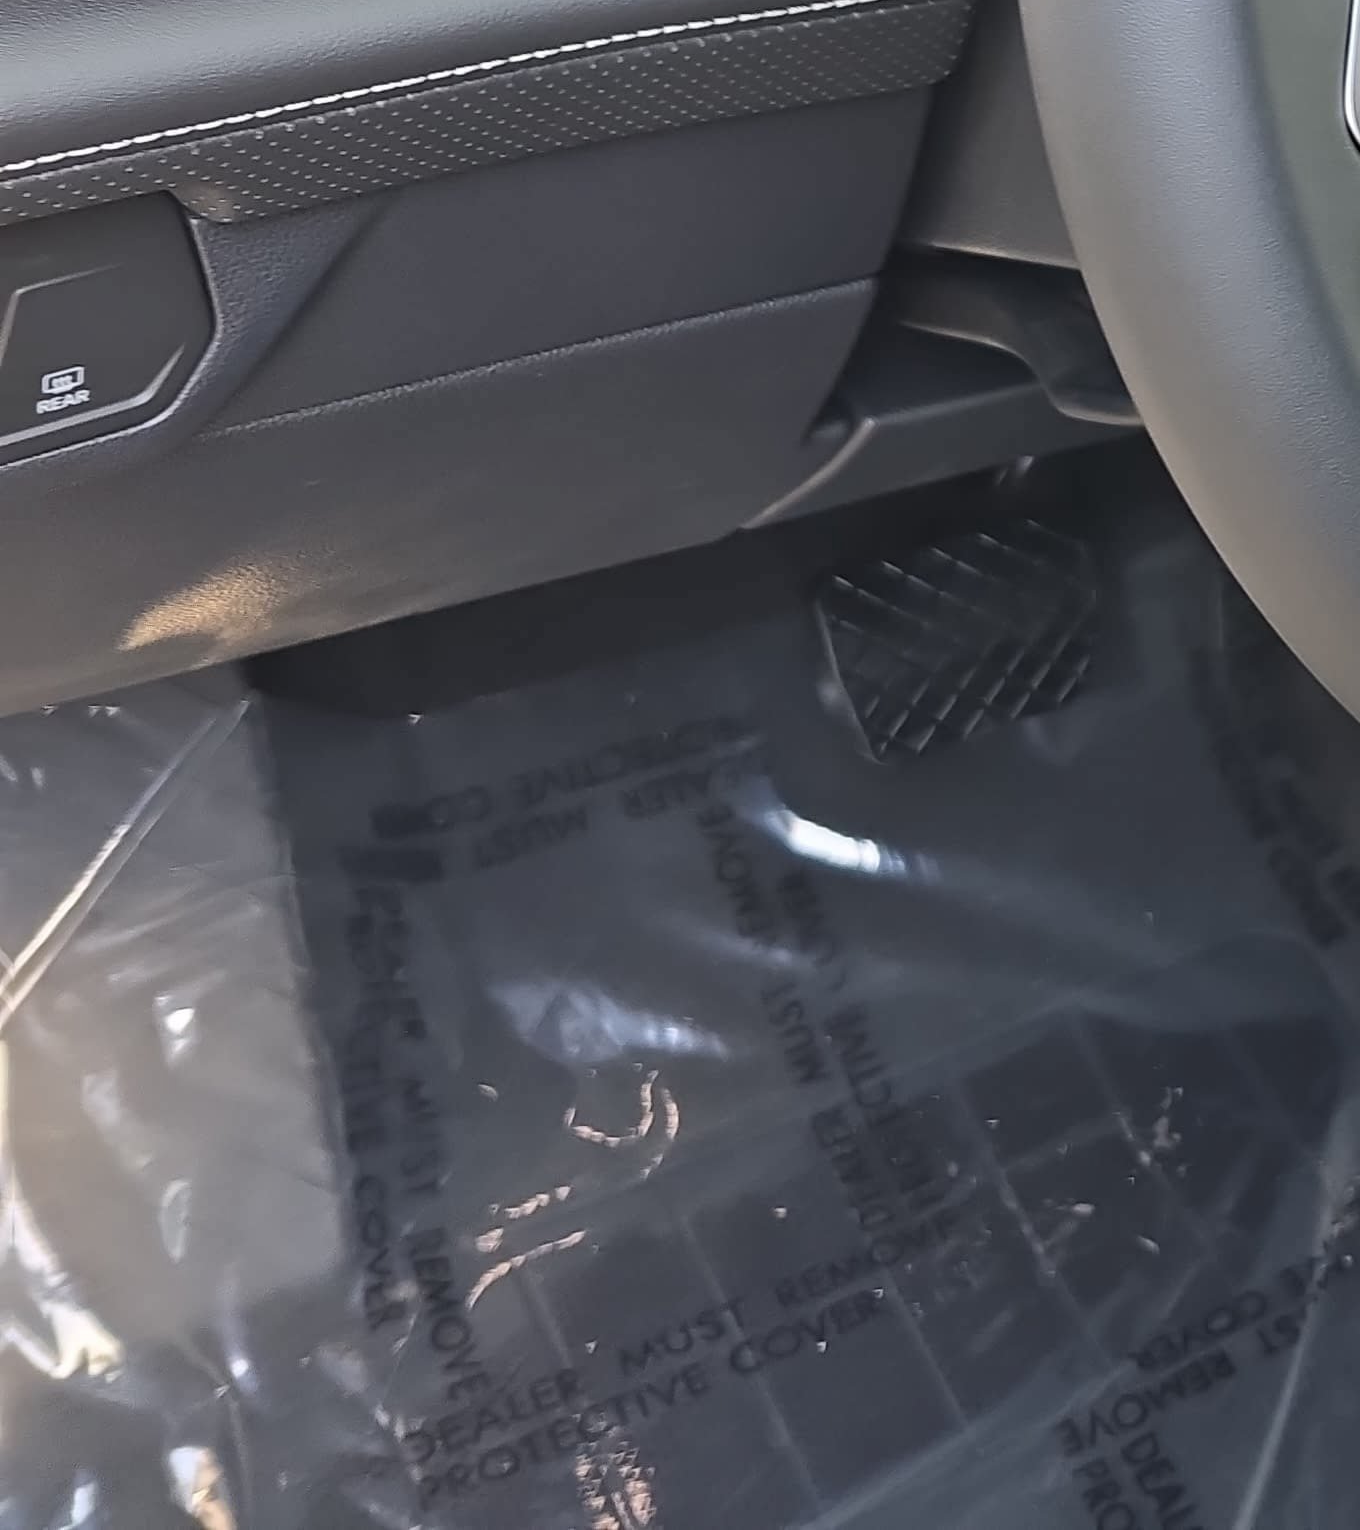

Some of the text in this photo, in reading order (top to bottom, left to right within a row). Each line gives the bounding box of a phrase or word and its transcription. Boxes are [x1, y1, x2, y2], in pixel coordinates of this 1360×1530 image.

[36, 388, 91, 415] REAR
[401, 1366, 580, 1464] DEALER
[617, 1294, 746, 1377] MUST
[405, 1226, 493, 1401] REMOVE
[1128, 1288, 1268, 1370] COVER
[419, 1289, 888, 1511] PROTECTIVE COVER
[1052, 1349, 1239, 1459] REMOVE
